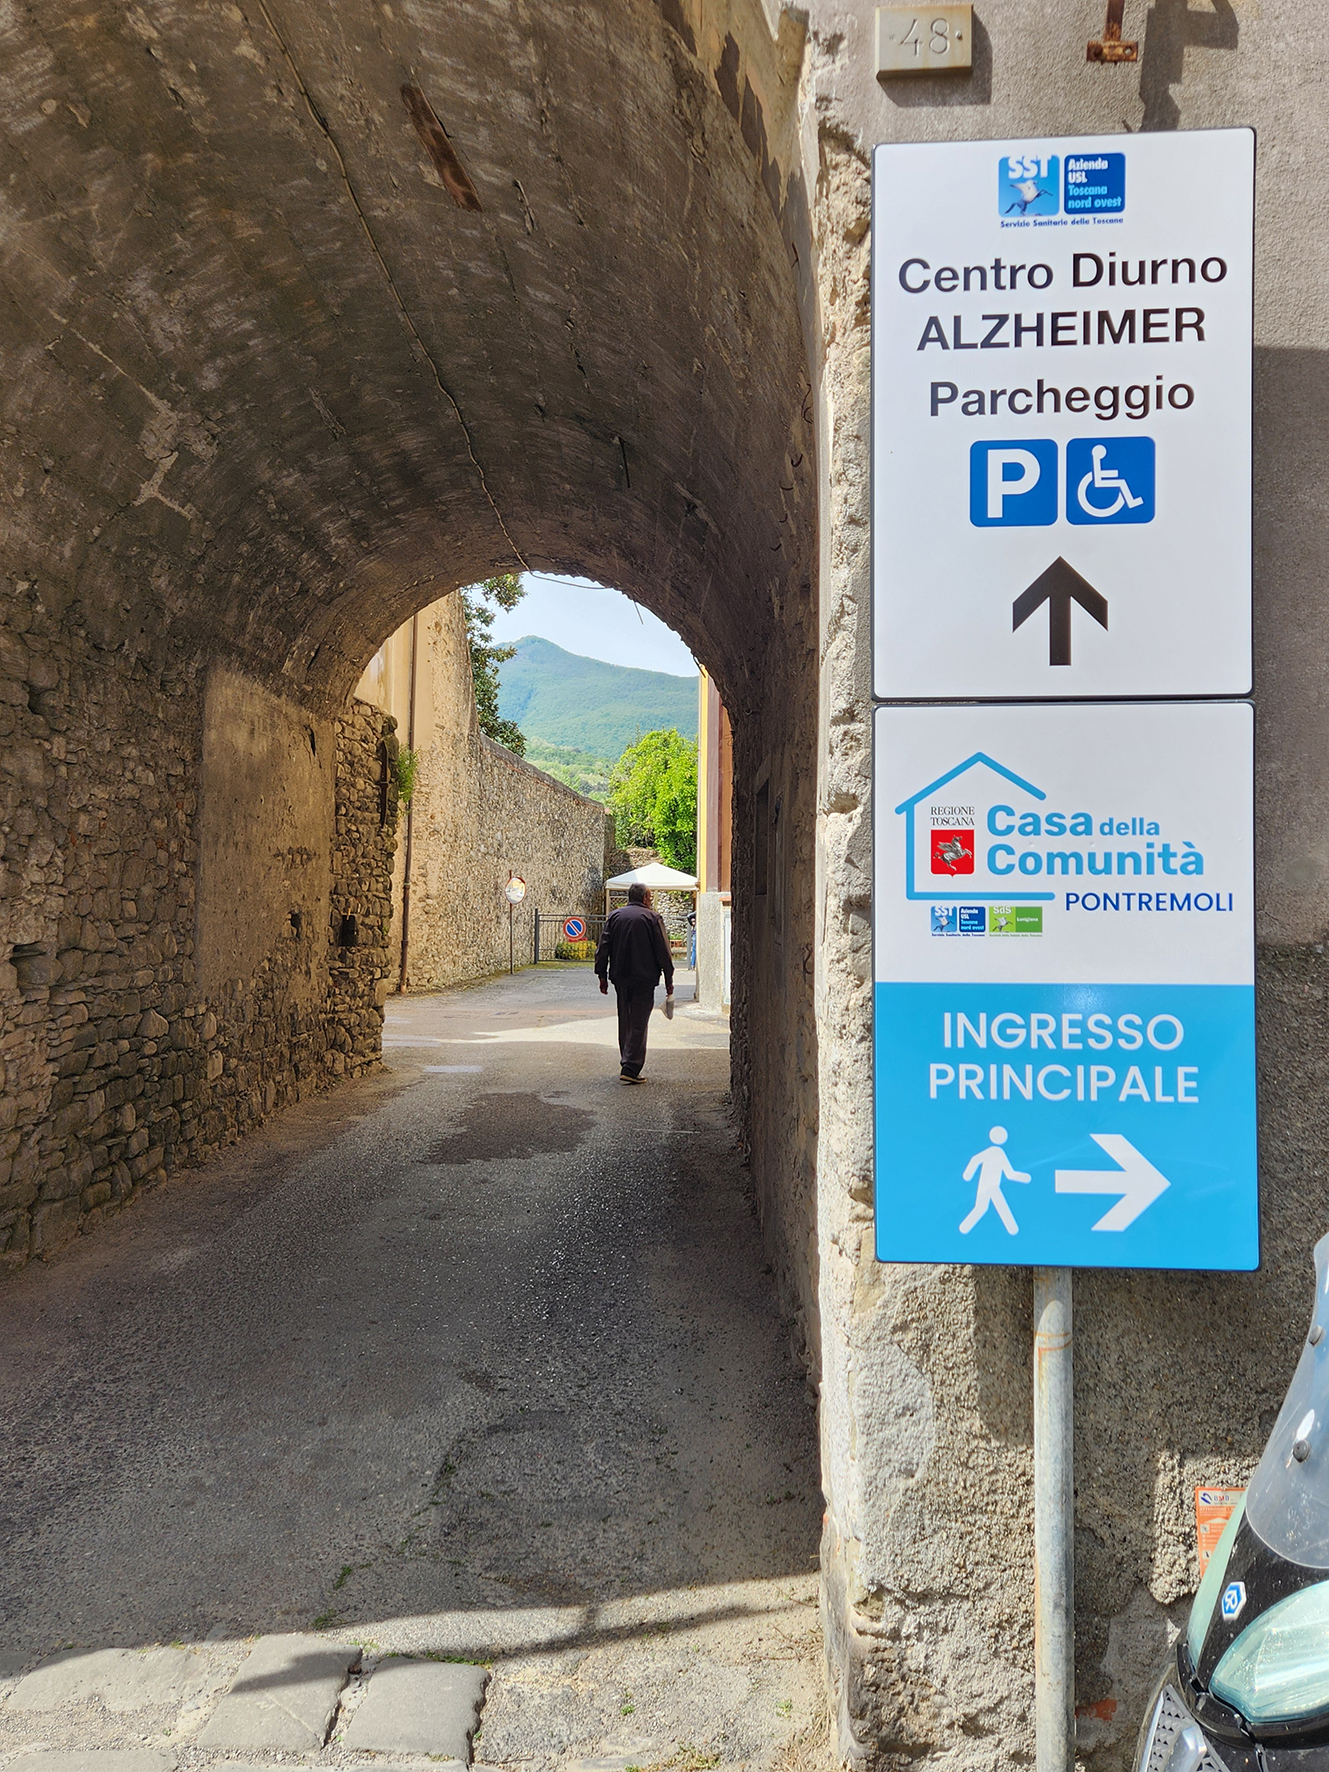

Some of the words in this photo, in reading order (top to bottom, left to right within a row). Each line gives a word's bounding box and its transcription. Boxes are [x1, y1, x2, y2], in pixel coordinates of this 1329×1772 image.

[900, 17, 950, 57] 48
[1008, 154, 1052, 179] SST
[1067, 157, 1109, 171] Azienda
[1067, 171, 1088, 184] USL
[1067, 184, 1108, 196] Toscana
[1067, 196, 1092, 209] nord
[1094, 196, 1122, 208] ovest
[1000, 220, 1031, 228] Servizio
[1033, 218, 1068, 227] Sanitario
[1071, 217, 1090, 226] della
[1093, 217, 1124, 225] Toscana
[898, 258, 1054, 294] Centro
[1072, 251, 1228, 288] Diurno
[916, 306, 1206, 351] ALZHEIMER
[929, 375, 1195, 421] Parcheggio
[987, 448, 1041, 518] P
[930, 806, 975, 817] REGIONE
[930, 816, 975, 827] TOSCANA
[986, 804, 1093, 837] Casa
[1099, 817, 1160, 836] della
[986, 841, 1205, 876] Comunità
[993, 906, 1012, 914] SdS
[1065, 892, 1234, 912] PONTREMOLI
[943, 1012, 1185, 1051] INGRESSO
[929, 1063, 1200, 1104] PRINCIPALE
